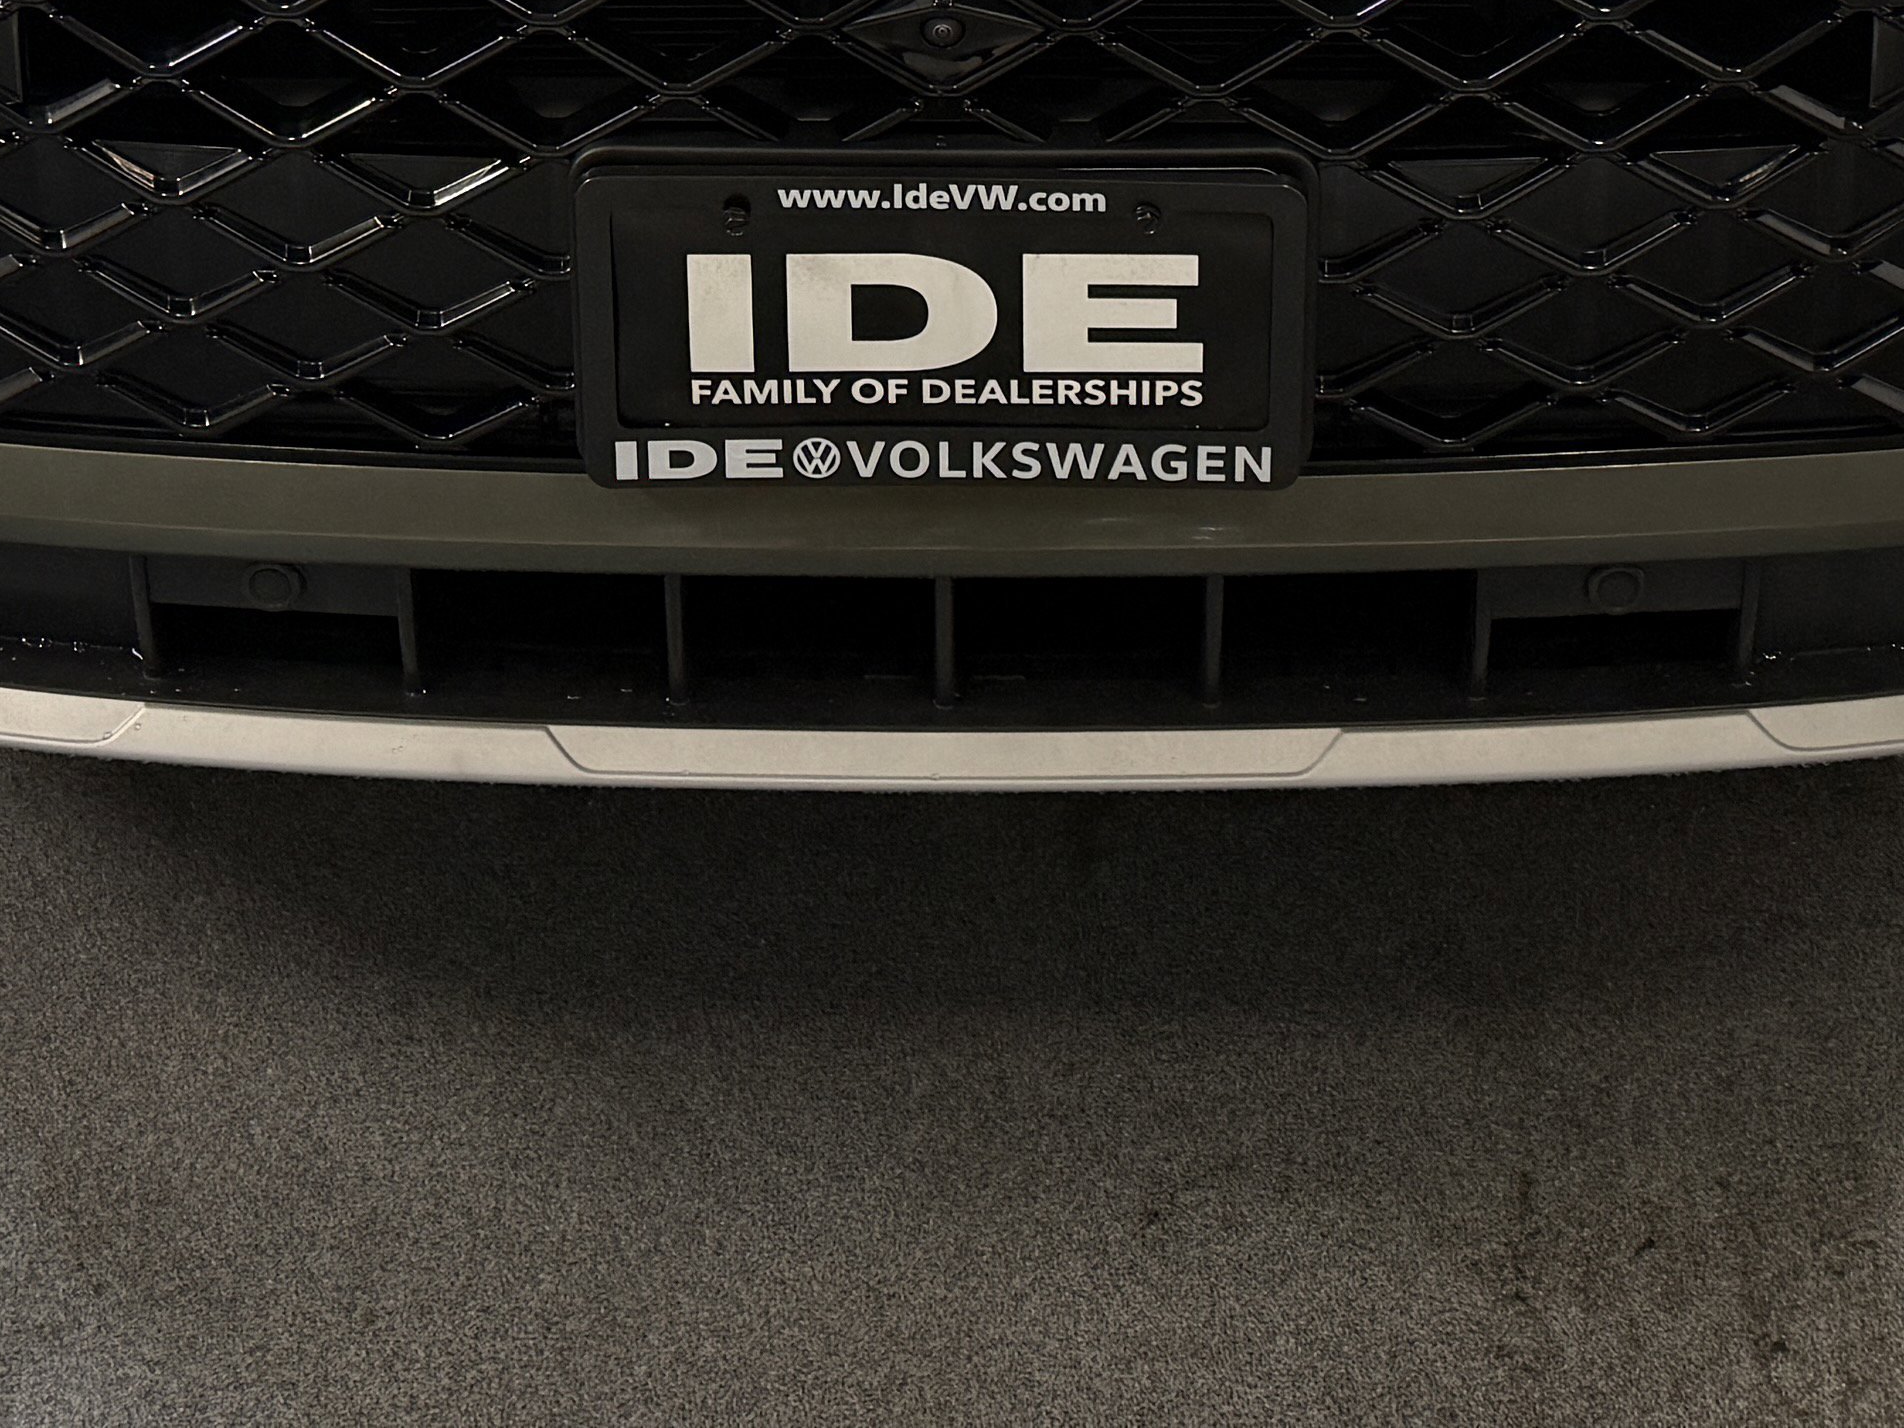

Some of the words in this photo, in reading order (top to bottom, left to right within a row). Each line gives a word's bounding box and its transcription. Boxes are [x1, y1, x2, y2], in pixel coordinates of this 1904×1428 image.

[777, 182, 1107, 213] www.IdeVW.com
[686, 252, 1204, 374] IDE
[691, 378, 841, 405] FAMILY
[851, 377, 909, 404] OF
[921, 378, 1203, 407] DEALERSHIPS
[614, 438, 784, 481] IDE
[845, 440, 1272, 483] VOLKSWAGEN
